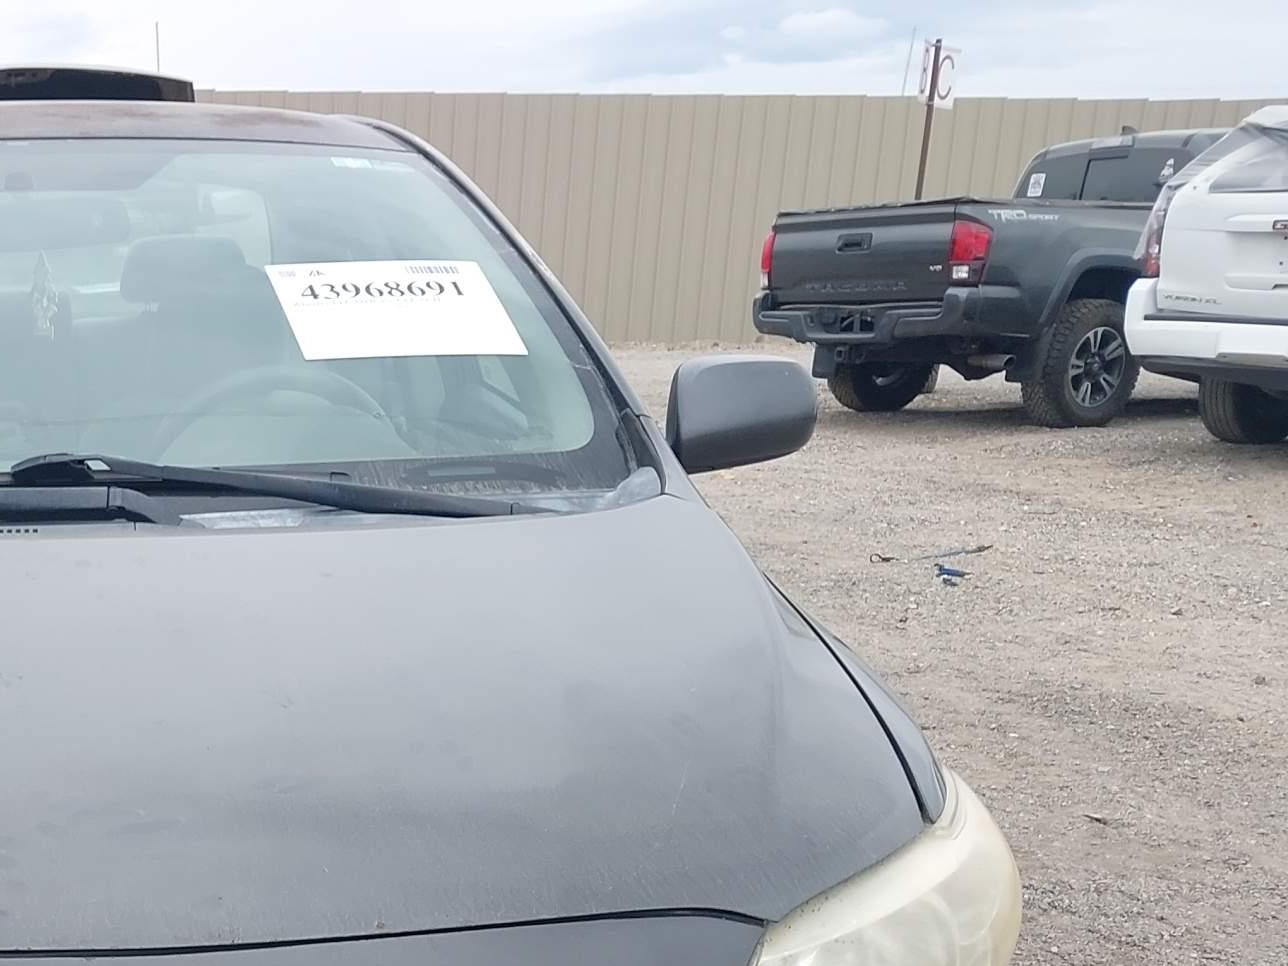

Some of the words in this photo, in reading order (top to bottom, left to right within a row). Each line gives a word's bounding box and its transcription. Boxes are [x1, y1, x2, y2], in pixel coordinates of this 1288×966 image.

[937, 54, 954, 100] C
[988, 209, 1026, 223] TRD
[301, 281, 464, 299] 43968691
